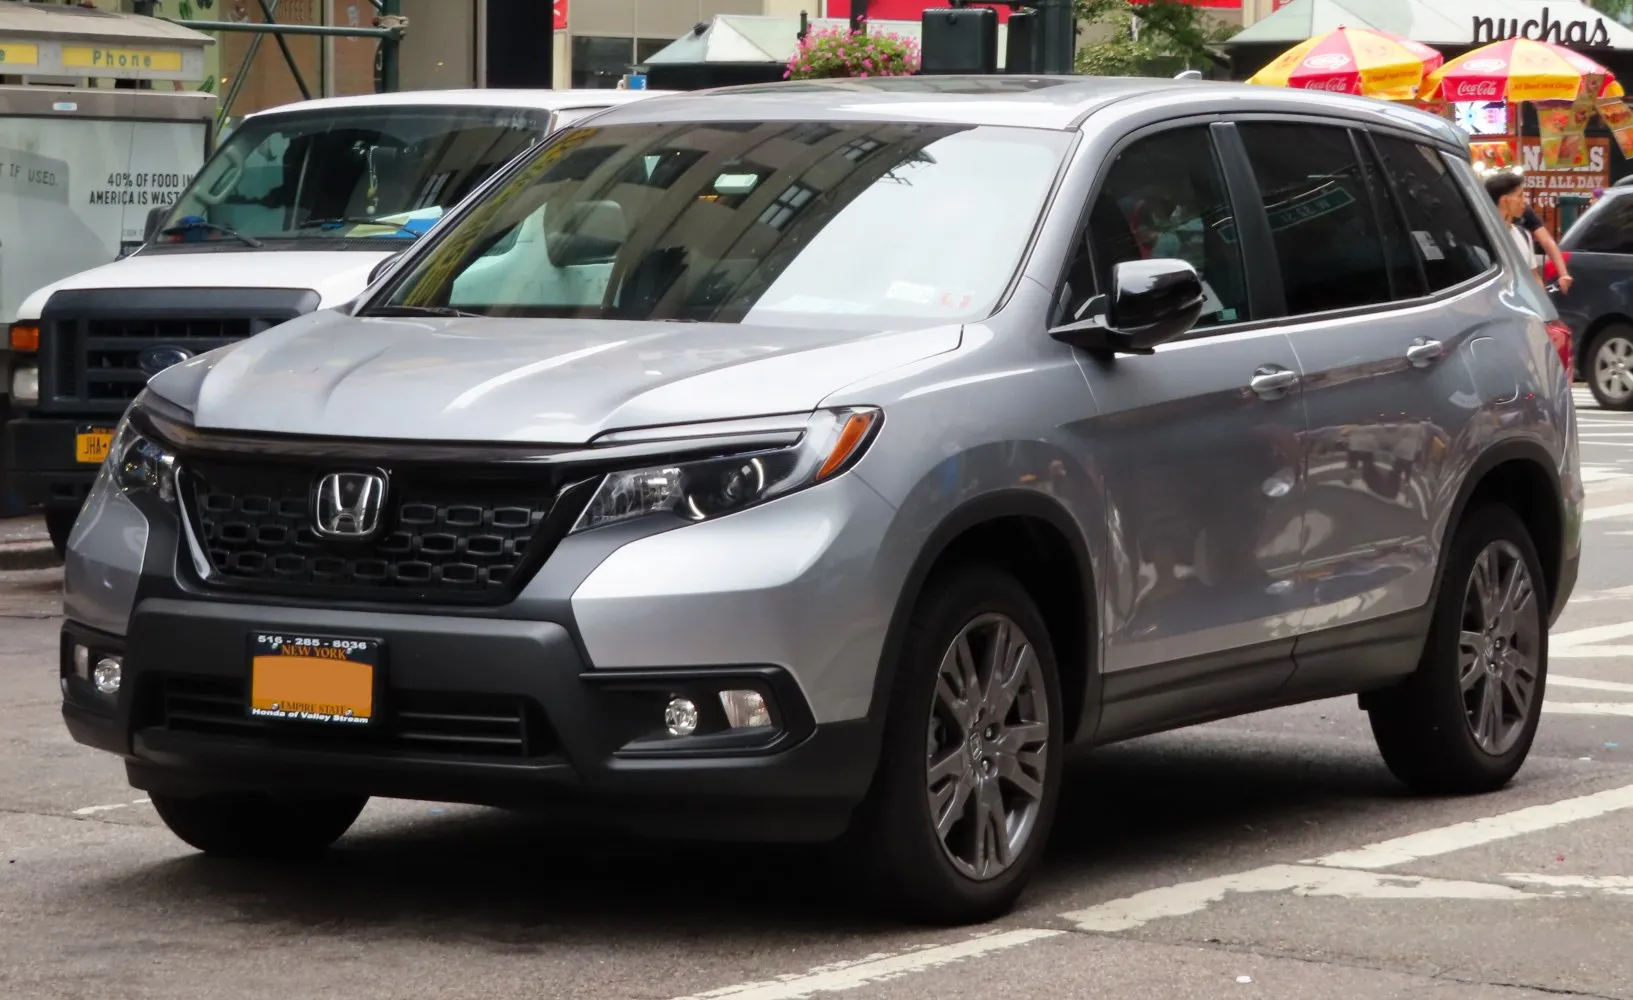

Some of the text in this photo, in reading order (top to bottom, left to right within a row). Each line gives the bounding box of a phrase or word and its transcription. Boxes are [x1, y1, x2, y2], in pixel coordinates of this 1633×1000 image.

[1472, 7, 1611, 46] nuchas
[92, 50, 152, 68] Phone
[1457, 81, 1497, 96] Coca-Cola
[10, 163, 22, 178] IF
[107, 172, 133, 188] 40%
[136, 173, 149, 188] OF
[152, 173, 179, 188] FOOD
[1548, 175, 1575, 188] ALL
[1577, 175, 1604, 188] DAY
[89, 191, 135, 205] AMERICA
[138, 191, 148, 205] IS
[257, 635, 283, 644] 516
[295, 637, 320, 646] 285
[281, 645, 348, 660] NEW YORK
[280, 700, 347, 715] EMPIRE STATE
[252, 708, 285, 717] Honda
[300, 711, 331, 722] Valley
[333, 714, 369, 724] Stream
